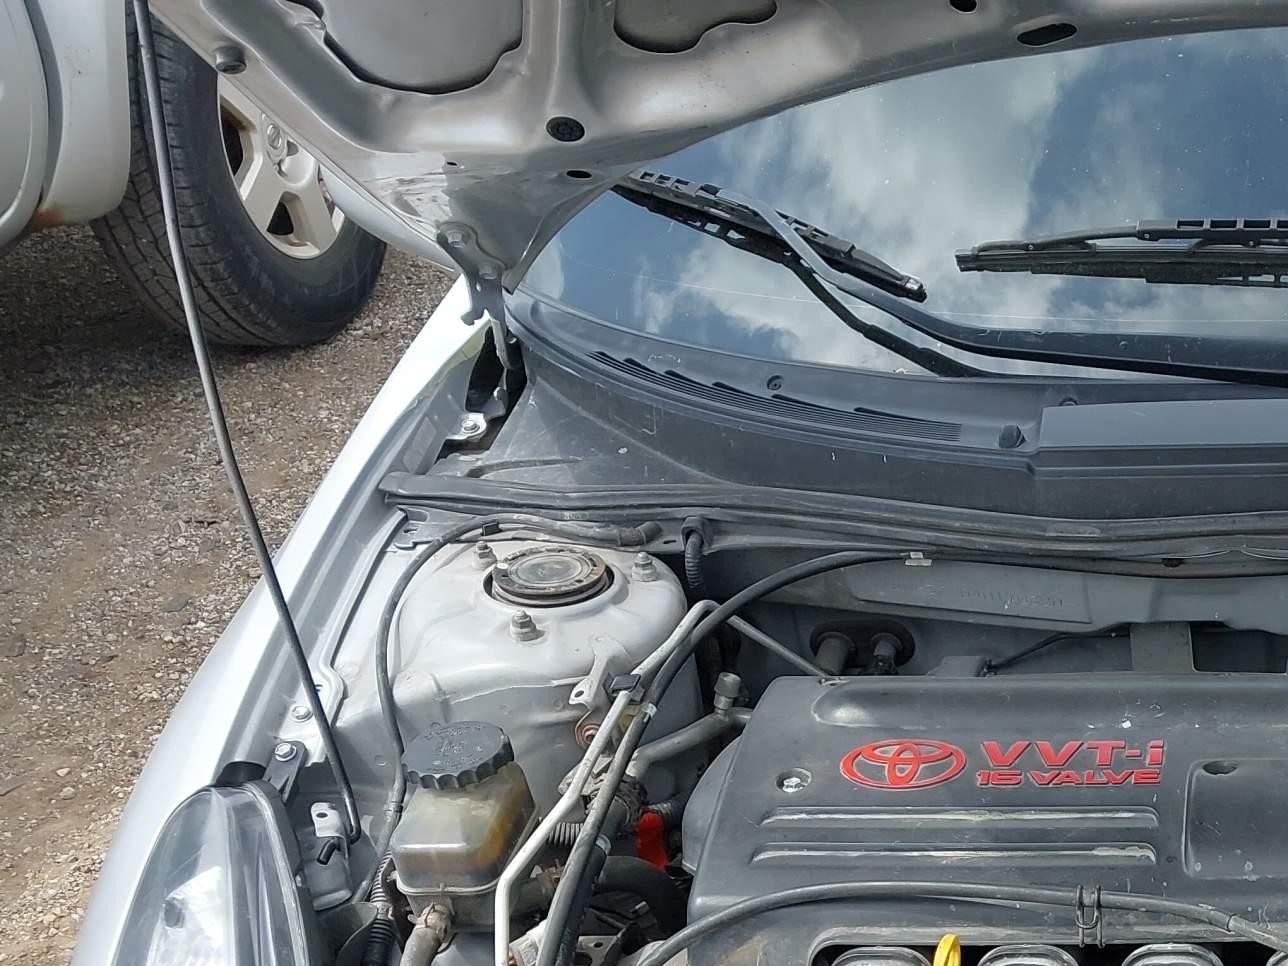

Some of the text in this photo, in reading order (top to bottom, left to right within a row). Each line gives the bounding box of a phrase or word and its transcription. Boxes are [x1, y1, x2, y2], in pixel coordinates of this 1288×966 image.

[981, 739, 1166, 767] VVT-i
[977, 768, 1162, 787] 16 VALVE
